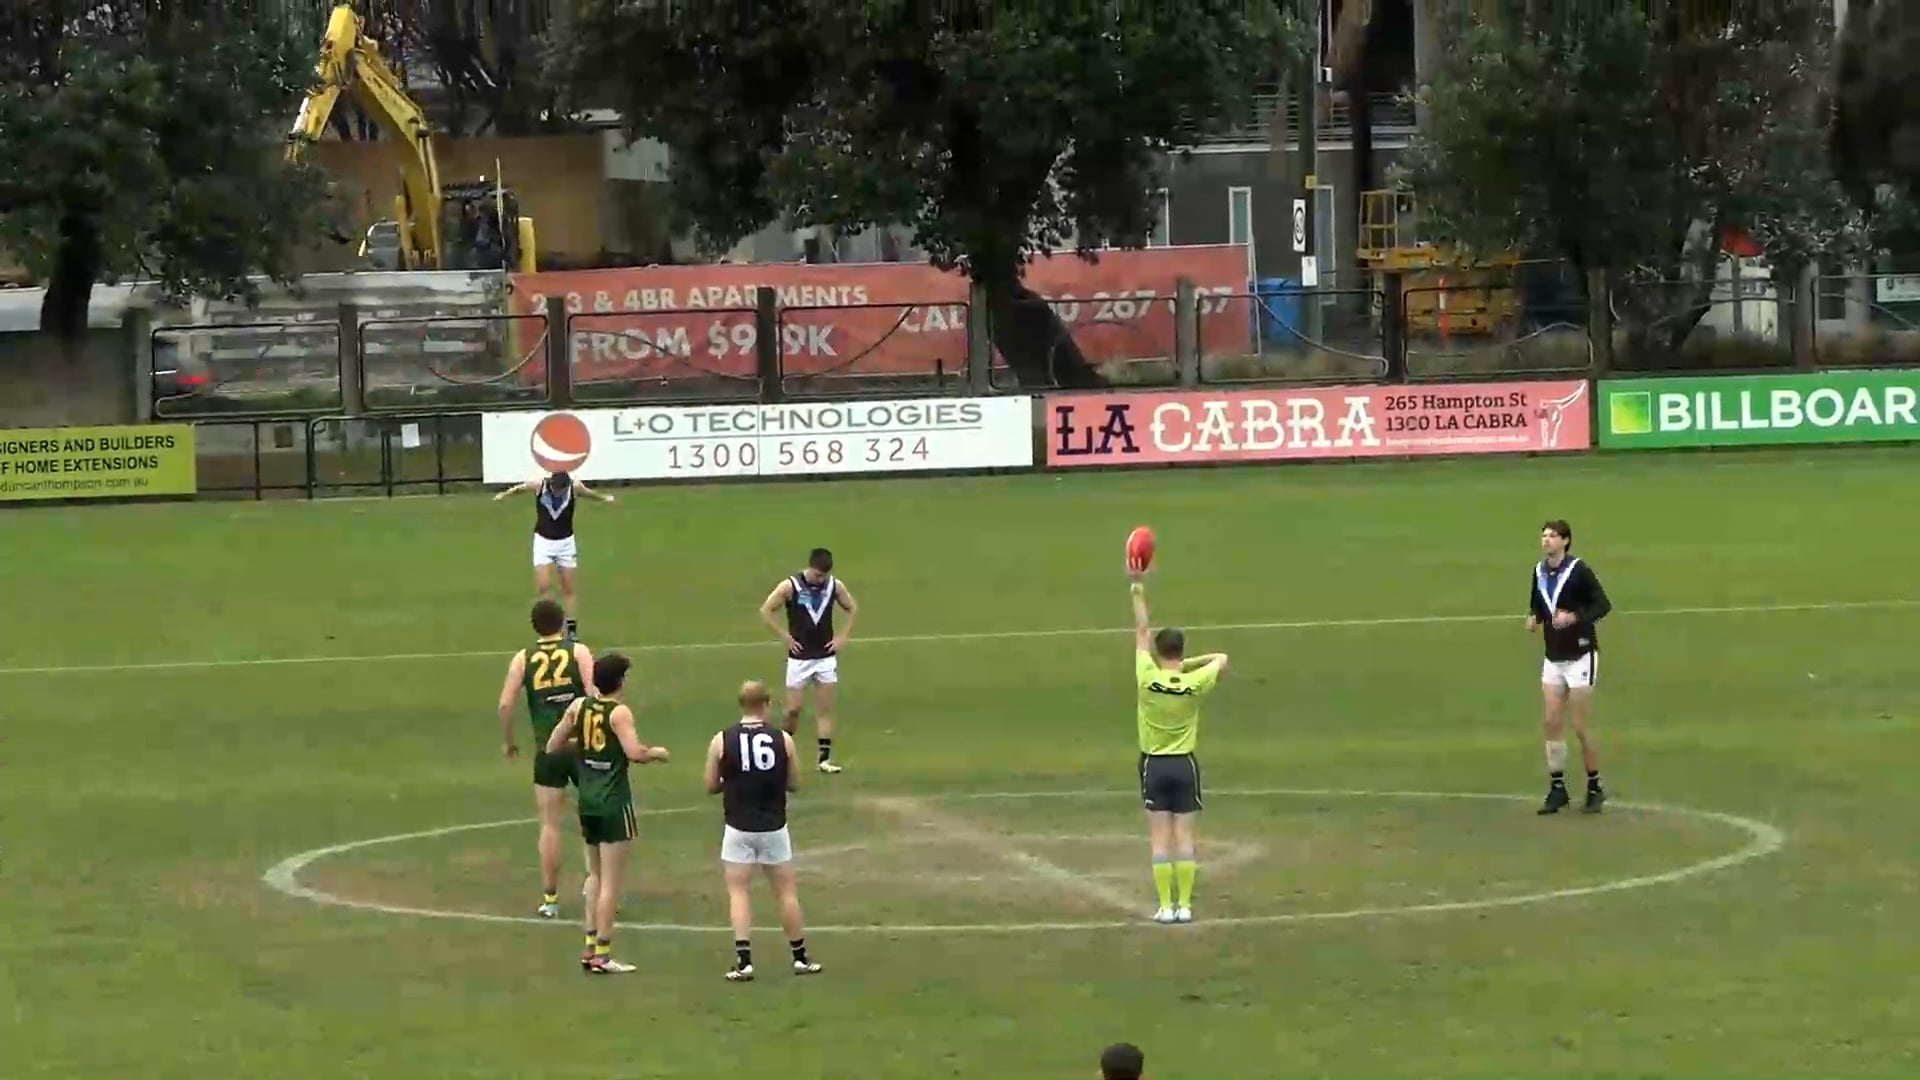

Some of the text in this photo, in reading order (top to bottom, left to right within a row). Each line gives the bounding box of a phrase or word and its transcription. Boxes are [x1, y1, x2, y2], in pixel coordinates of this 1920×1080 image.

[593, 290, 613, 312] &
[623, 287, 677, 310] 4BR
[687, 284, 869, 309] APARMENTS
[1091, 288, 1157, 321] 267
[572, 320, 838, 363] FROM $99K
[1384, 392, 1528, 413] 265 Hampton St
[613, 403, 984, 436] L+O TECHNOLOGIES
[1056, 396, 1381, 456] LA CABRA
[1435, 414, 1460, 430] LA
[1463, 412, 1528, 429] CABRA
[63, 438, 96, 452] AND
[100, 435, 175, 450] BUILDERS
[667, 436, 930, 469] 1300 568 324
[15, 458, 59, 474] HOME
[64, 455, 159, 472] EXTENSIONS
[530, 648, 572, 692] 22
[583, 707, 607, 753] 16
[739, 733, 776, 772] 16
